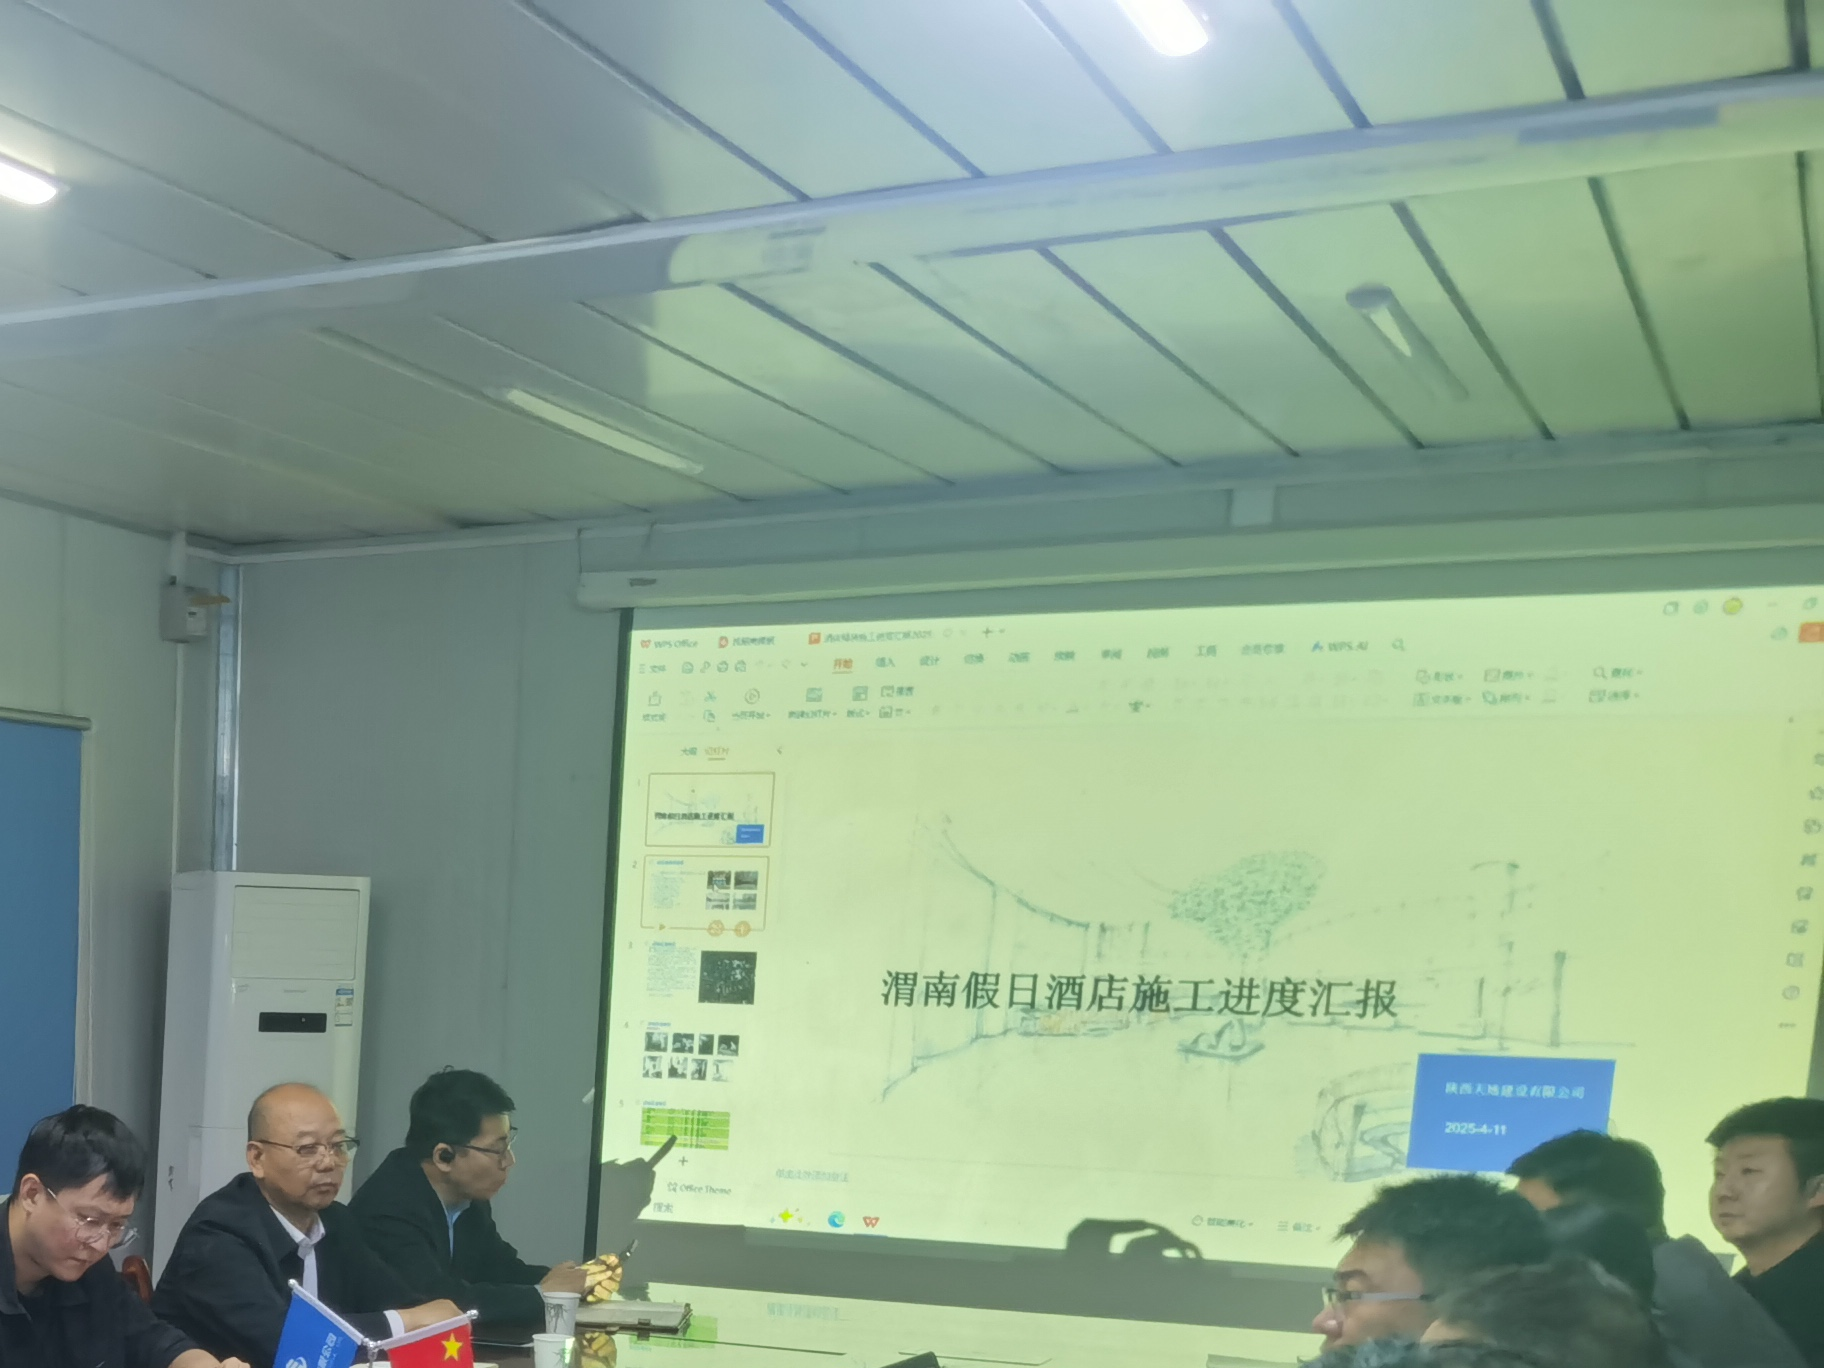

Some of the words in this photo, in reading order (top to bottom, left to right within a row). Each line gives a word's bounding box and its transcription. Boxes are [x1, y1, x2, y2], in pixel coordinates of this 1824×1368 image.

[881, 969, 1398, 1019] 渭南假日酒店施工进度汇报
[1444, 1122, 1508, 1136] 2025-4-11
